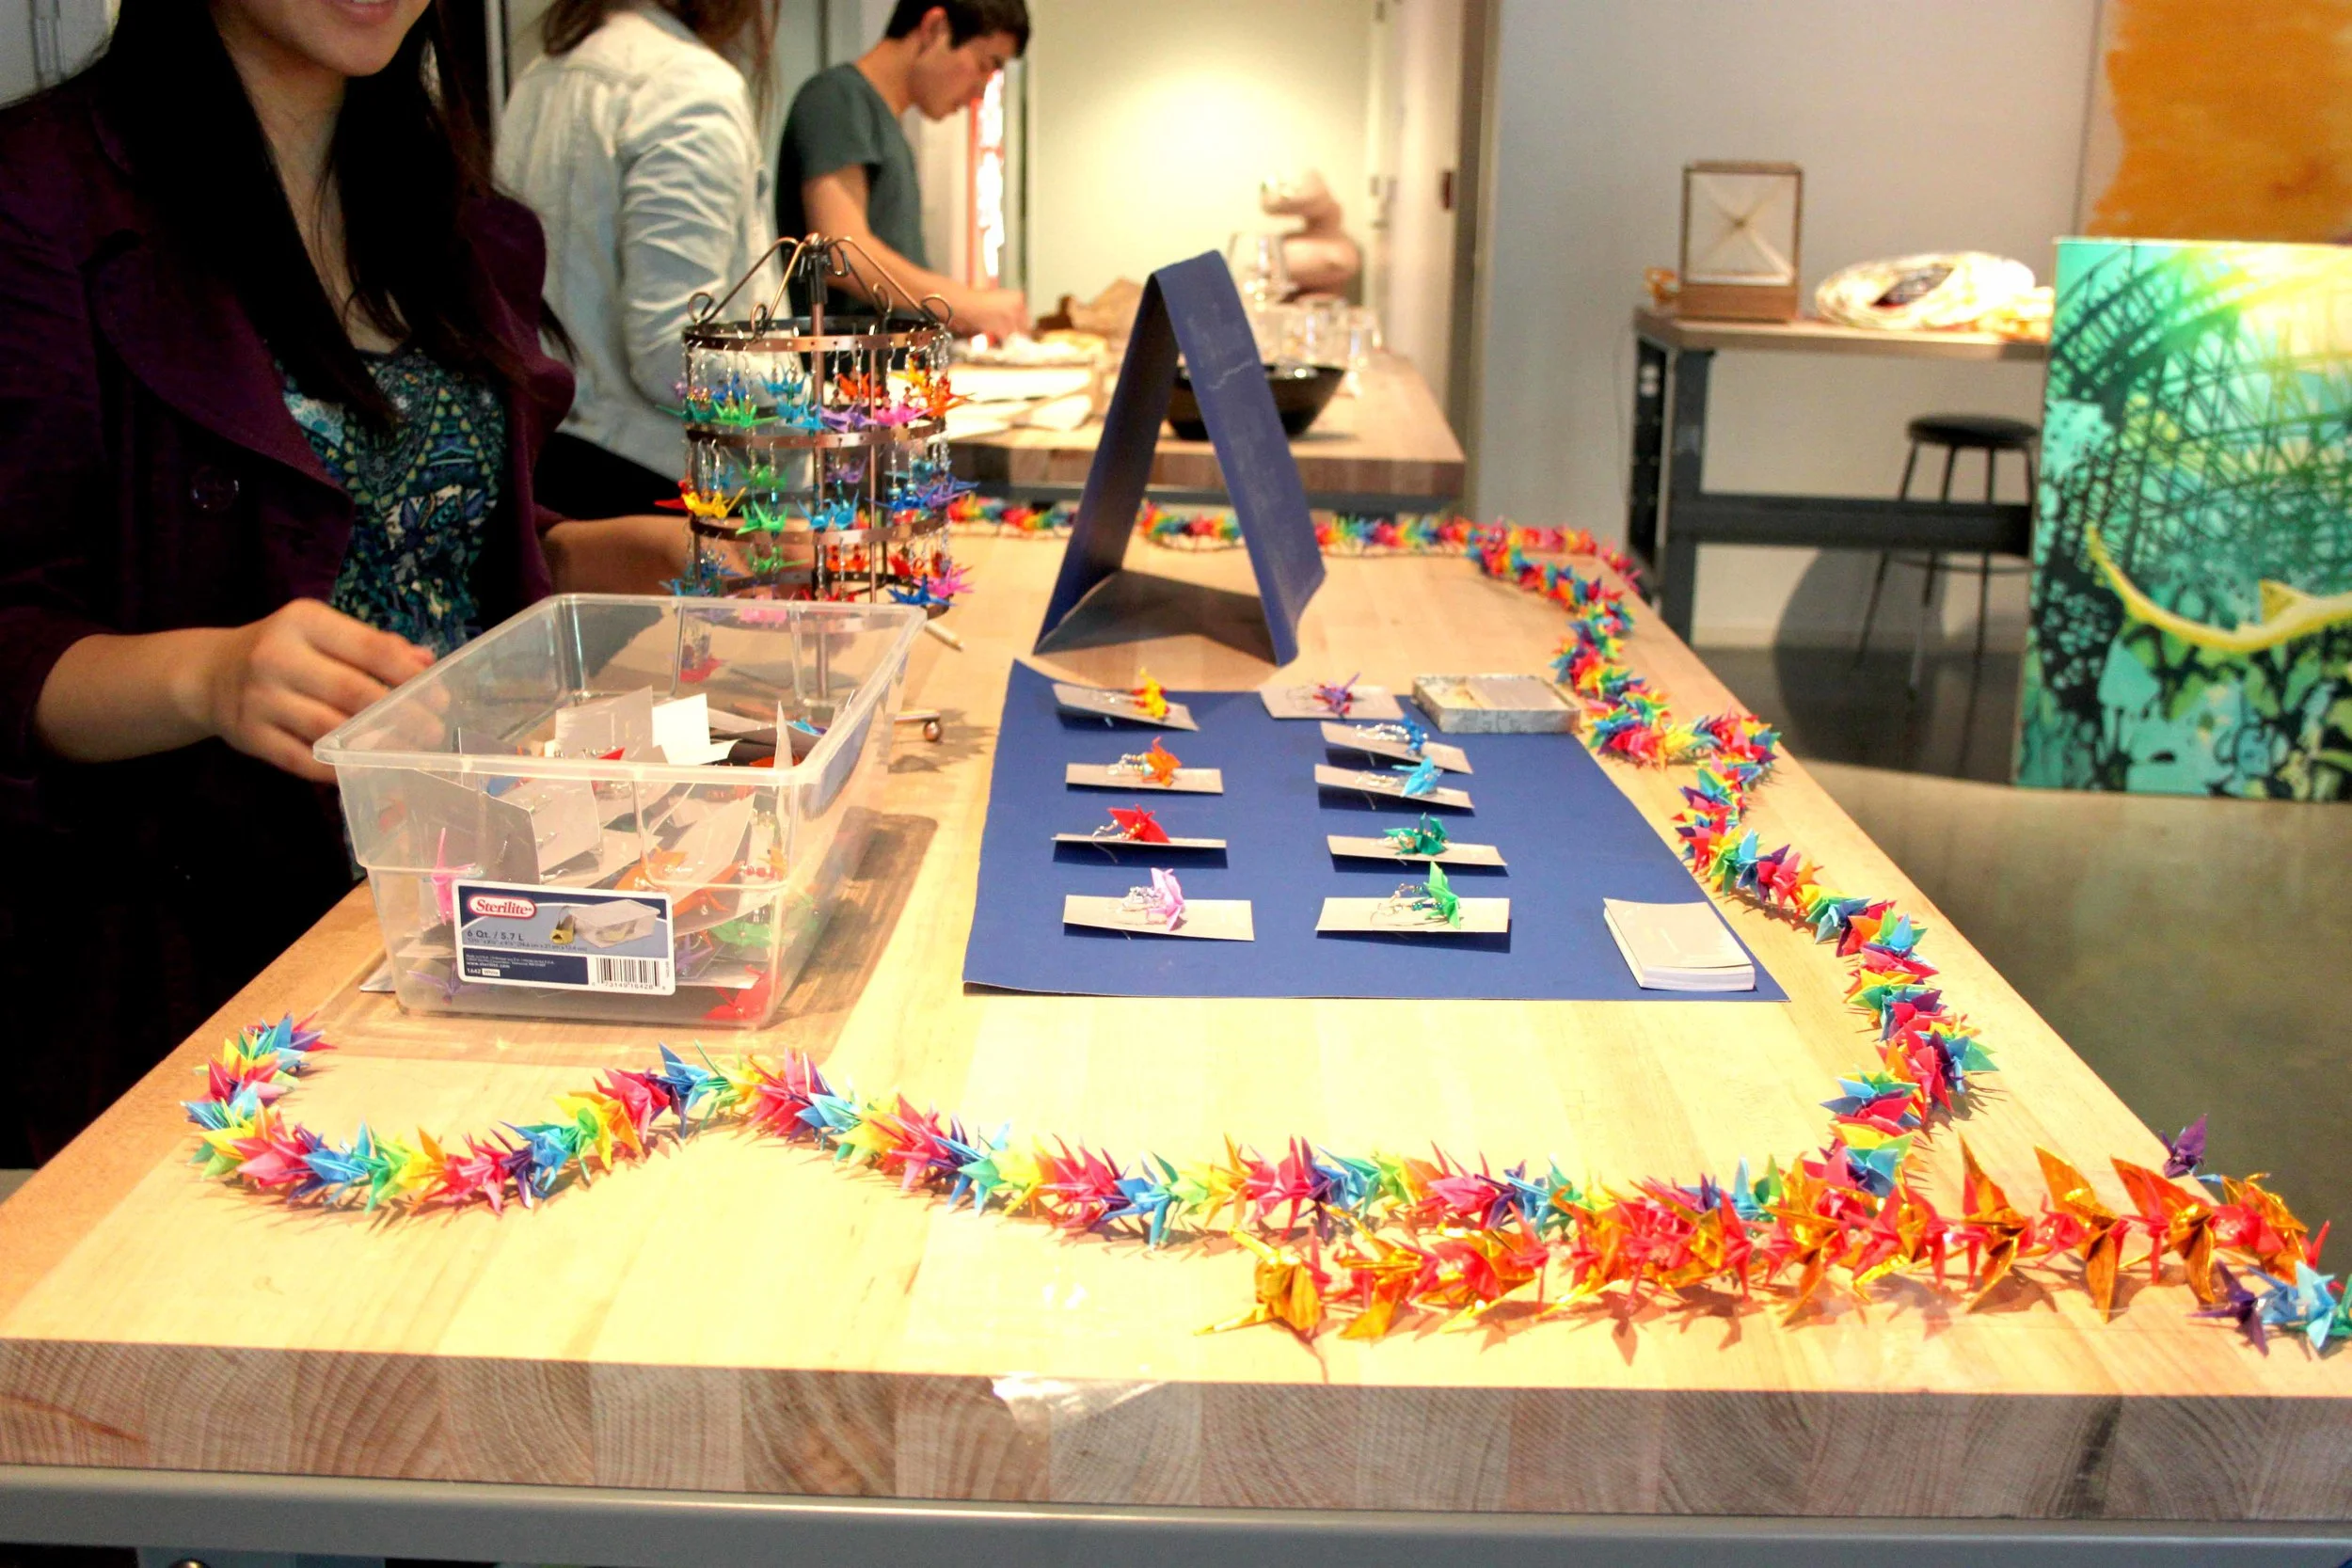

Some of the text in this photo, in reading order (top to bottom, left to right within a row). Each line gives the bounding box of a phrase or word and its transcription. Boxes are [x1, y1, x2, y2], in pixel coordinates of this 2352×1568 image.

[476, 899, 528, 915] Sterilite
[476, 930, 491, 939] Qt.
[493, 931, 499, 940] /
[501, 932, 516, 941] 5.7
[518, 933, 525, 942] L
